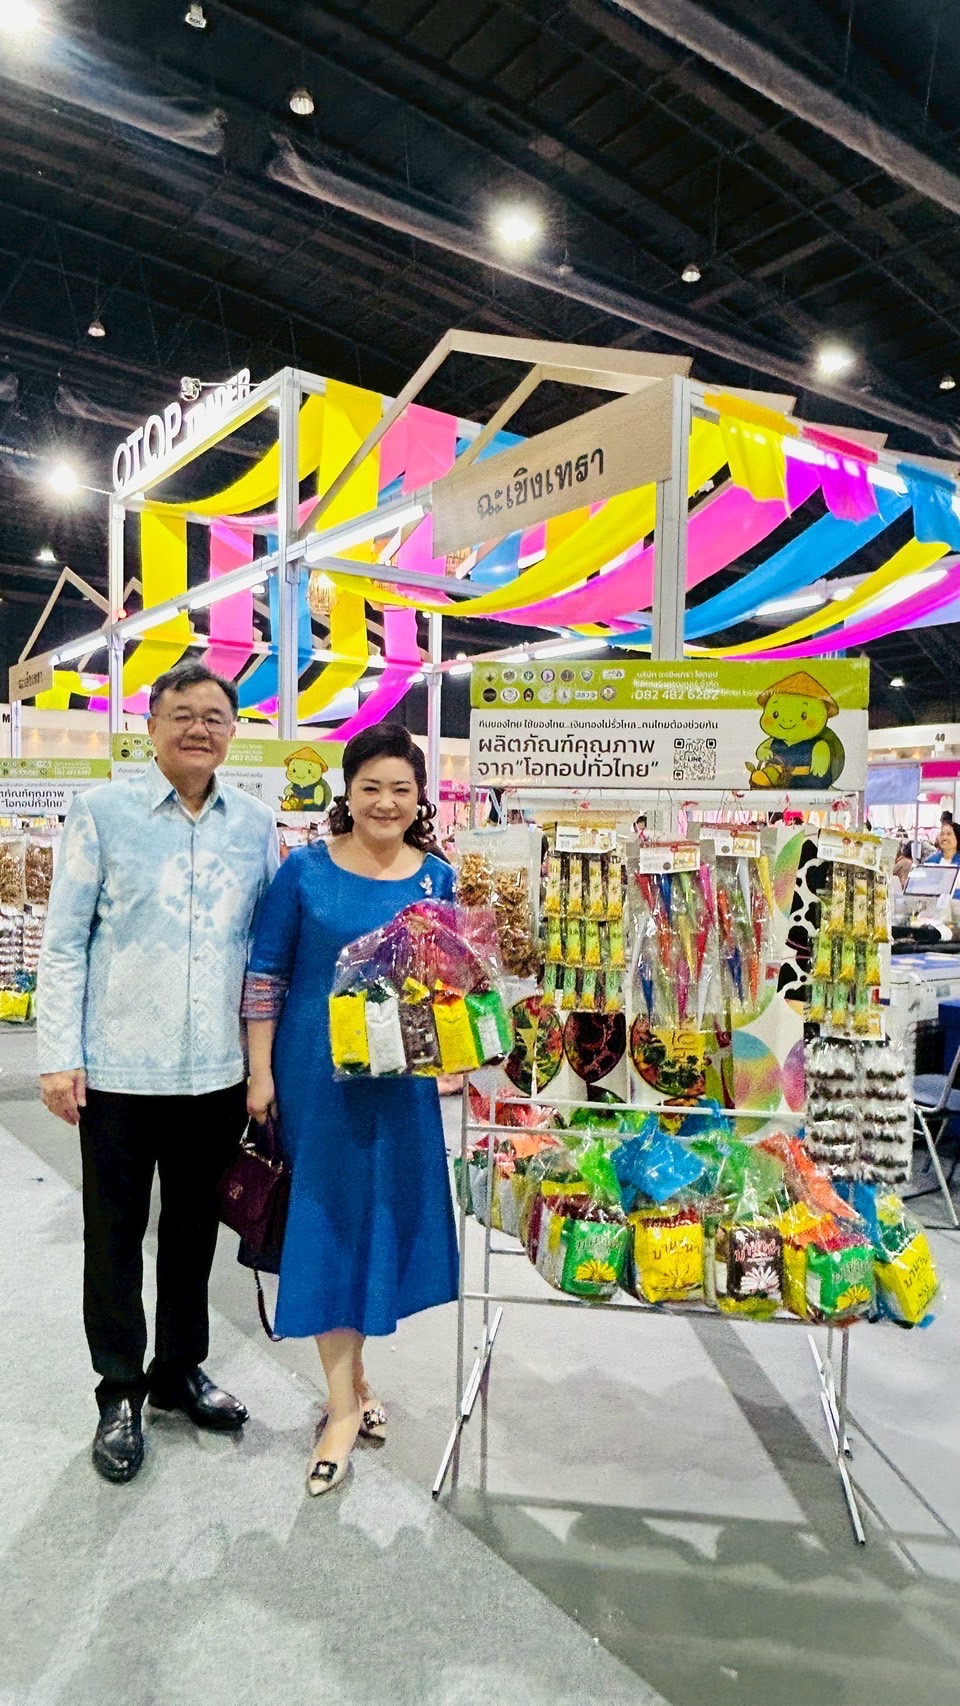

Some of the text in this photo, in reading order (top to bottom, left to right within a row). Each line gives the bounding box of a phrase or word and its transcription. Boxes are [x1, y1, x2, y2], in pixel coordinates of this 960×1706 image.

[112, 401, 183, 492] OTOP
[477, 447, 605, 521] ฉะเชิงเทรา
[2, 713, 11, 724] M
[479, 734, 655, 759] ผลิตภัณฑ์คุณภาพ
